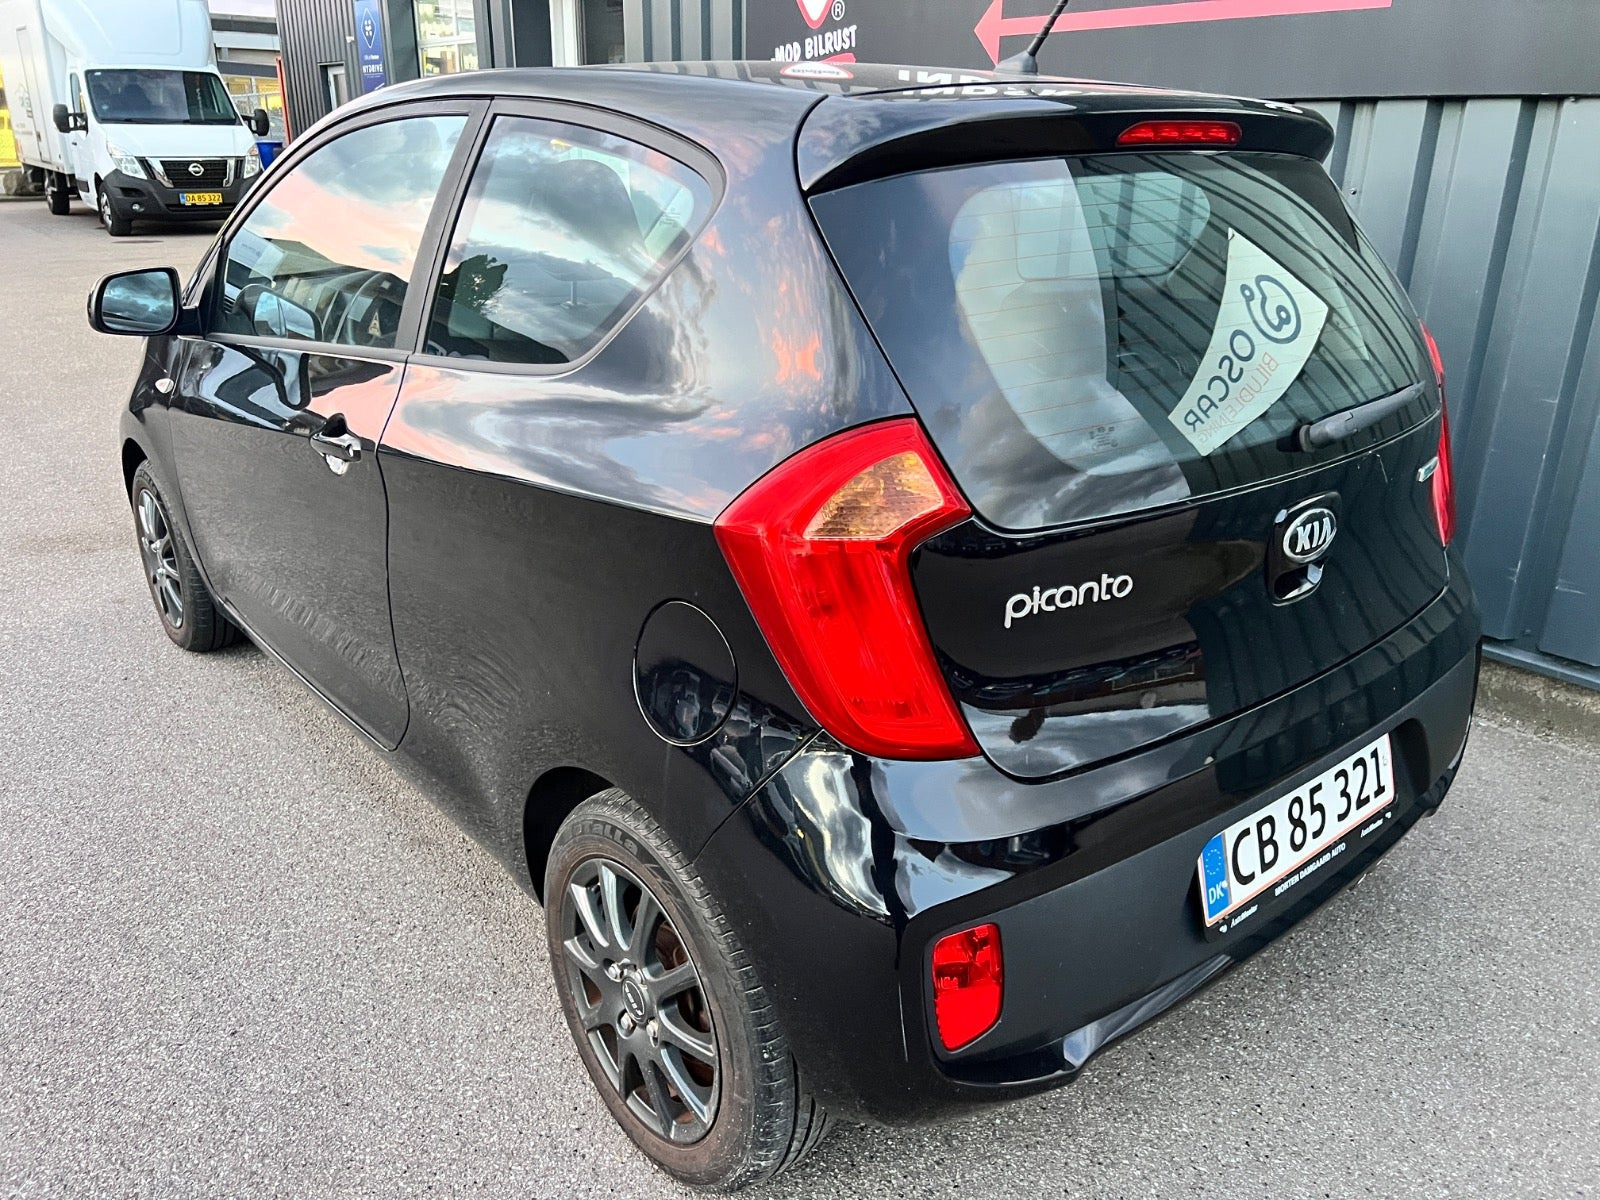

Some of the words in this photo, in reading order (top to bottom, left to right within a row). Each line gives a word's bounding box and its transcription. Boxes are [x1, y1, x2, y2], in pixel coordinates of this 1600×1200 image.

[804, 25, 857, 59] BILRUST
[1295, 516, 1334, 553] KIA
[1004, 574, 1133, 628] picanto
[1232, 814, 1279, 886] CB
[1288, 782, 1326, 853] 85
[1334, 747, 1386, 823] 321
[1208, 882, 1225, 904] DK
